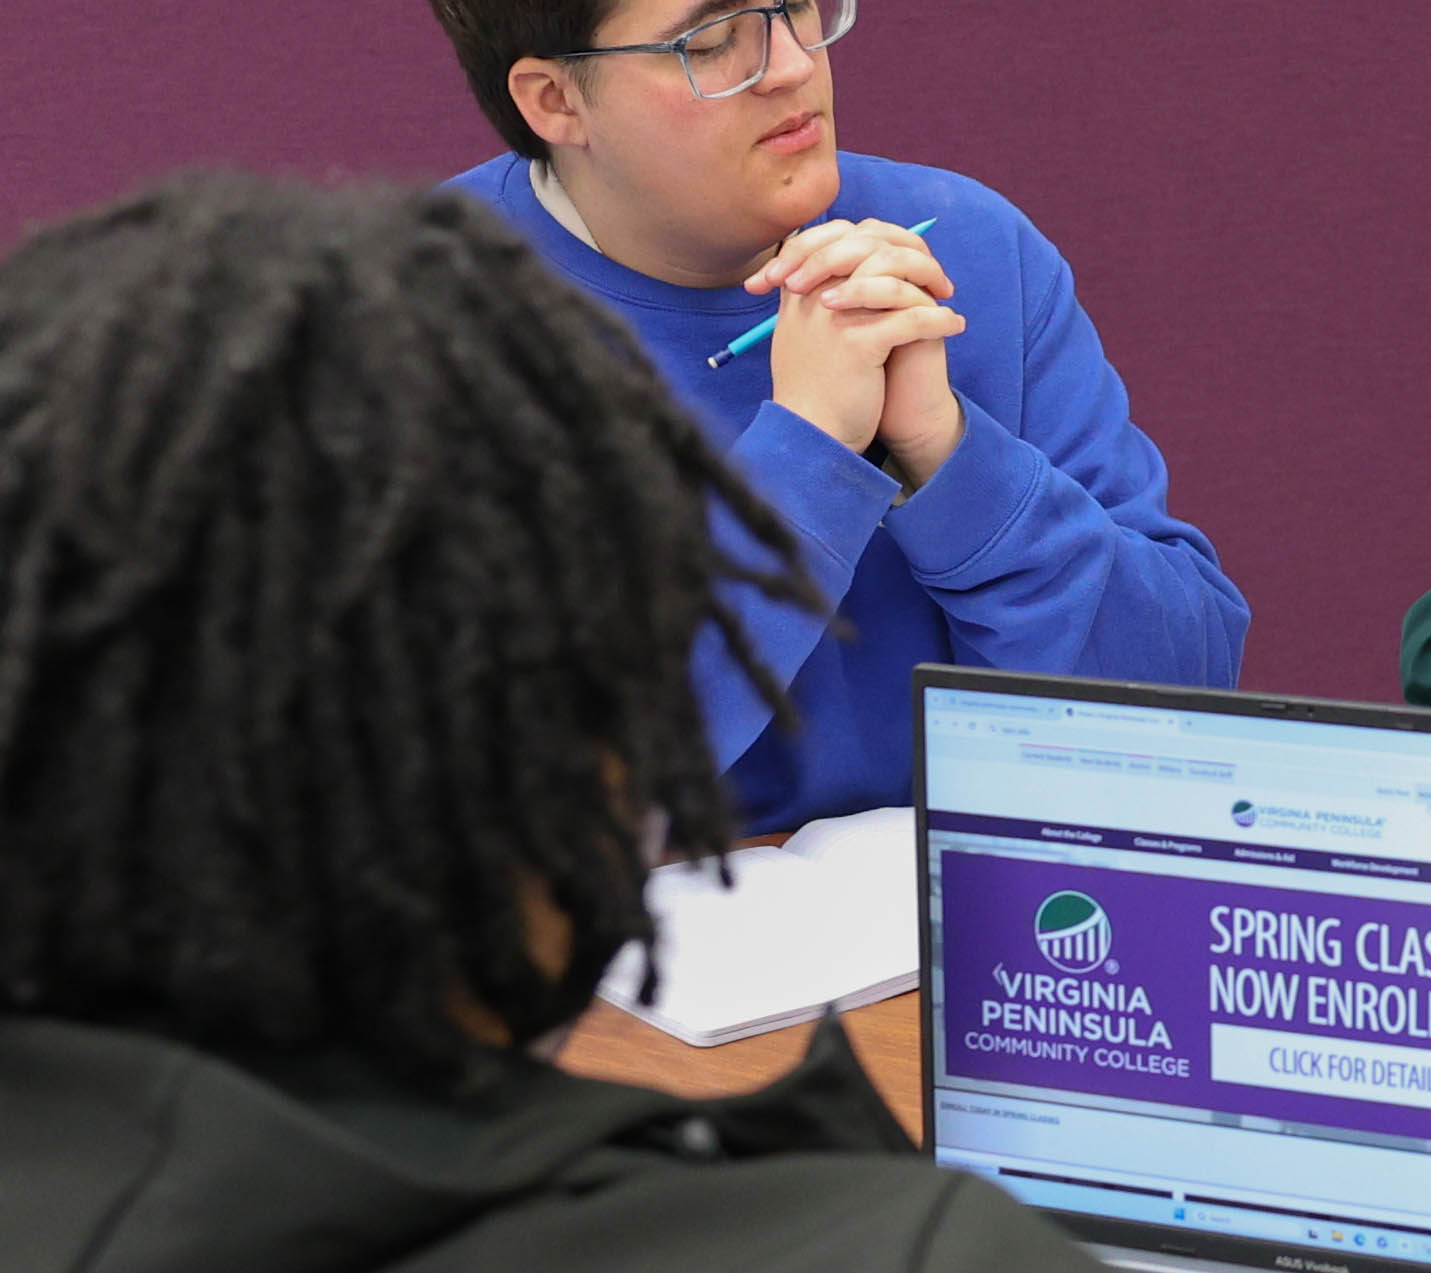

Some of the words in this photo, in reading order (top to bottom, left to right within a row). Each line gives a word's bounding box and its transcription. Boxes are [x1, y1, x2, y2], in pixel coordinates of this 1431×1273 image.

[1209, 905, 1342, 967] SPRING
[1000, 969, 1152, 1016] VIRGINIA
[1209, 964, 1300, 1021] NOW
[981, 999, 1173, 1050] PENINSULA
[964, 1031, 1089, 1064] COMMUNITY
[1093, 1048, 1190, 1078] COLLEGE
[1269, 1047, 1323, 1078] CLICK
[1327, 1054, 1366, 1084] FOR
[1274, 1255, 1303, 1270] ASUS
